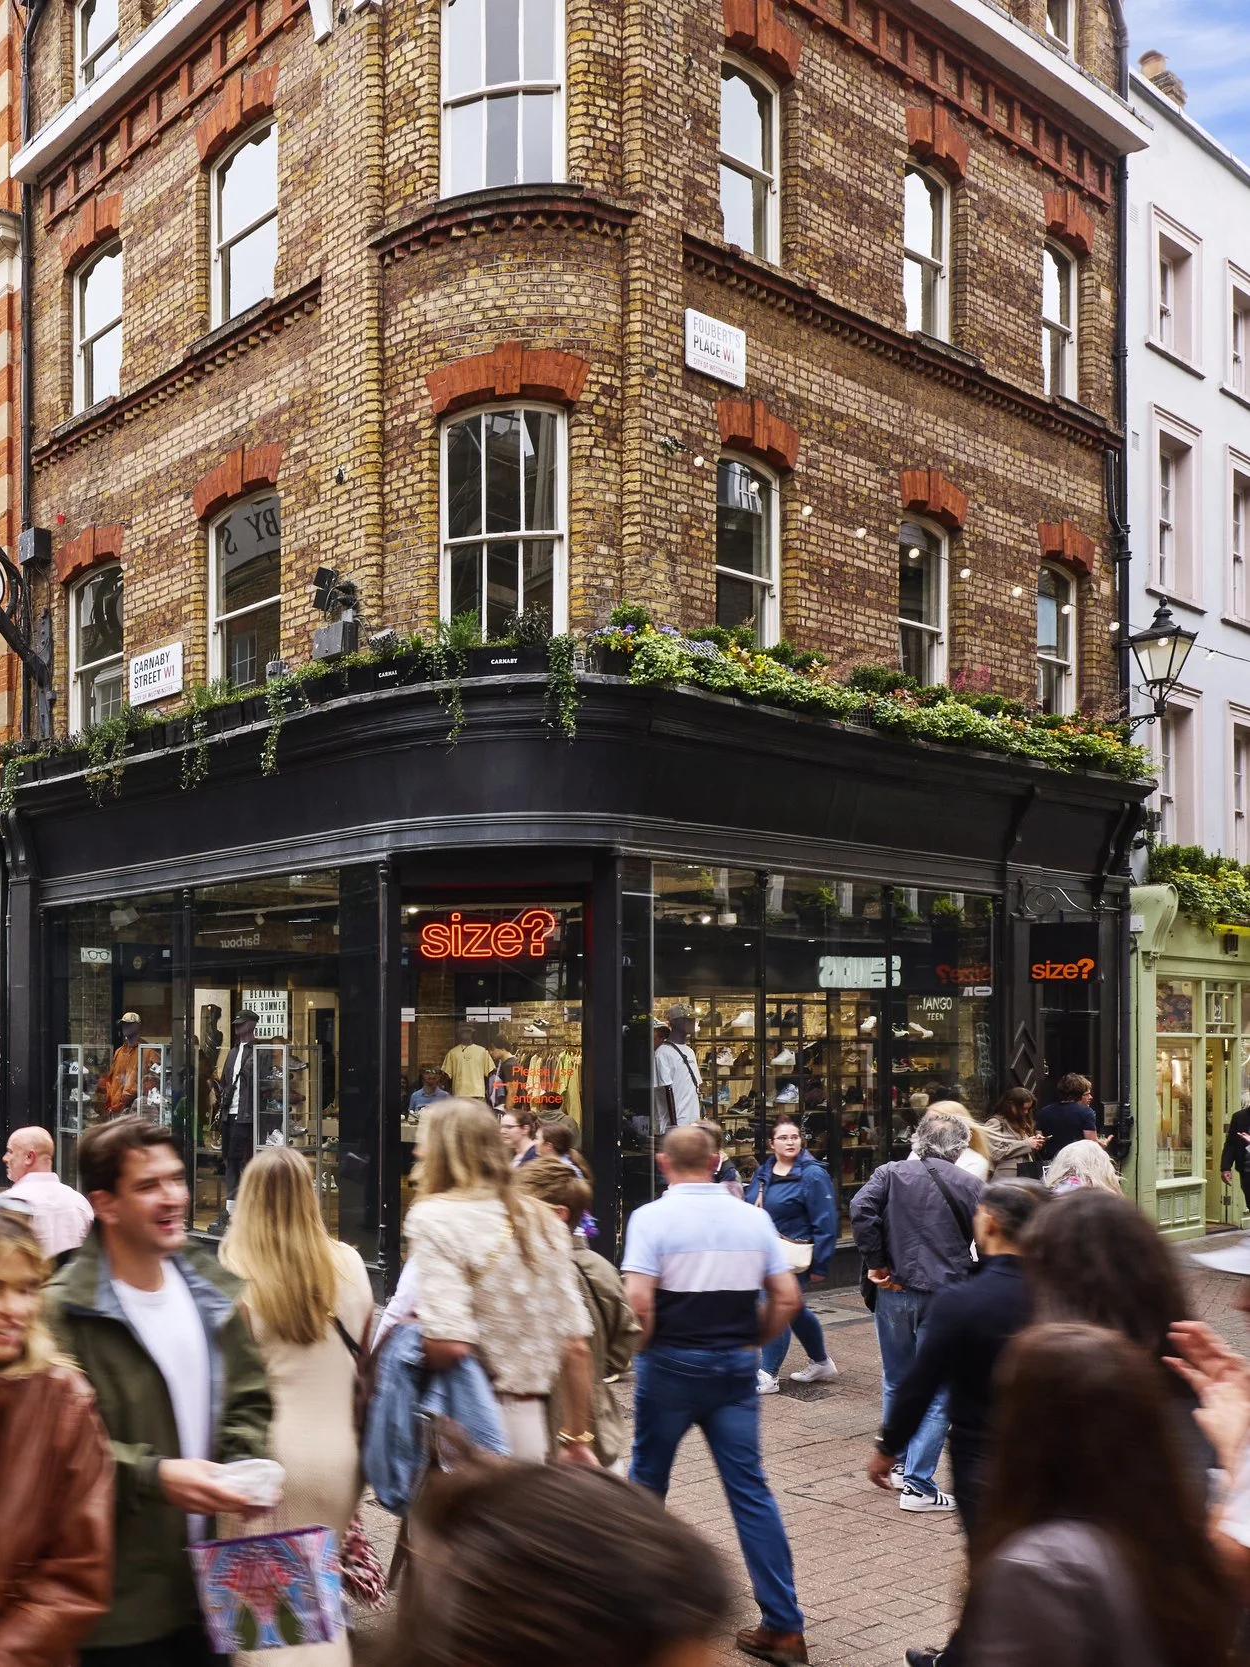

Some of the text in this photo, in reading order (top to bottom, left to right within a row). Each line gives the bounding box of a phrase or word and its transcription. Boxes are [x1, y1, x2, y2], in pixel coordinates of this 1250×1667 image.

[693, 316, 741, 349] FOUBERT'S
[693, 335, 735, 364] PLACE W1
[134, 650, 171, 675] CARNABY
[134, 664, 175, 689] STREET W1
[420, 909, 556, 958] size?
[1031, 957, 1095, 980] size?
[245, 1001, 286, 1011] THE SUMMER
[267, 1014, 284, 1023] WITH
[927, 1012, 945, 1021] TEEN
[512, 1065, 550, 1077] Please
[512, 1079, 562, 1090] the other
[511, 1094, 562, 1104] entrance
